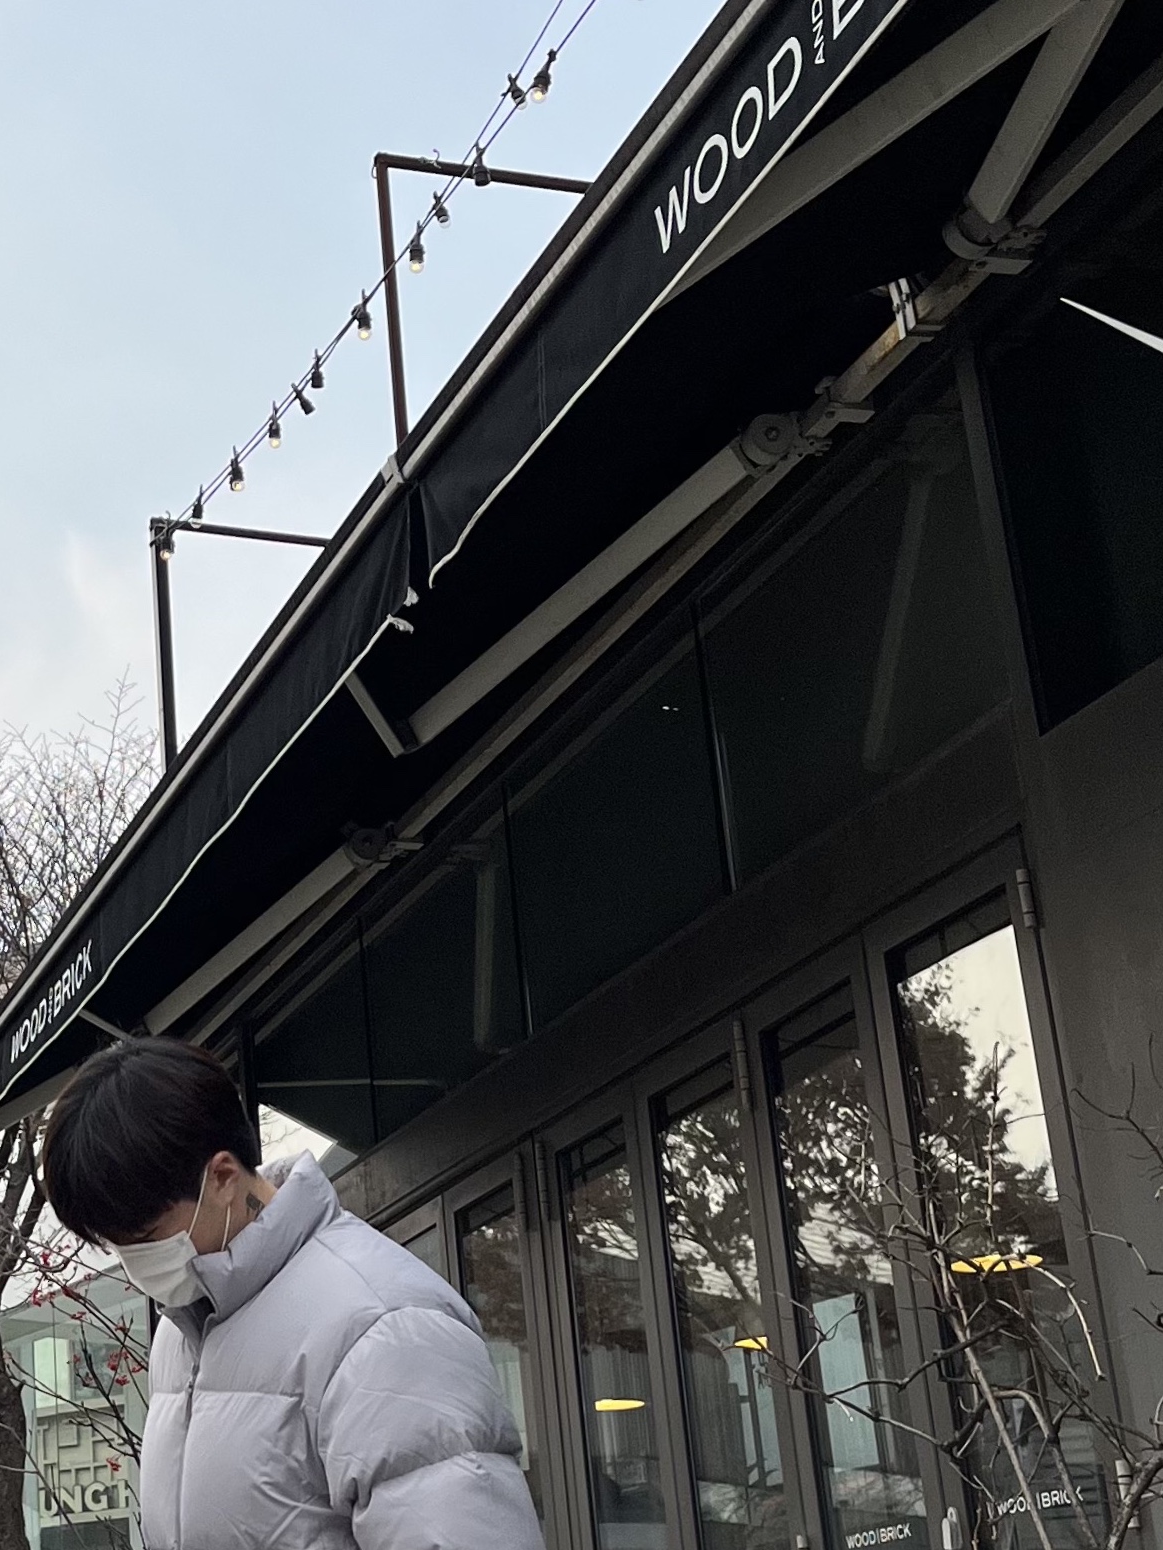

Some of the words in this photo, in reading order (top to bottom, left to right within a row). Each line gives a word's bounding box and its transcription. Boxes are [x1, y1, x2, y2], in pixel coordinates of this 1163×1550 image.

[654, 36, 803, 254] WOOD
[811, 0, 826, 65] AND
[10, 998, 47, 1064] WOOD
[53, 938, 92, 1018] BRICK
[845, 1530, 876, 1549] WOOD
[879, 1522, 912, 1542] BRICK
[997, 1496, 1035, 1516] WOO
